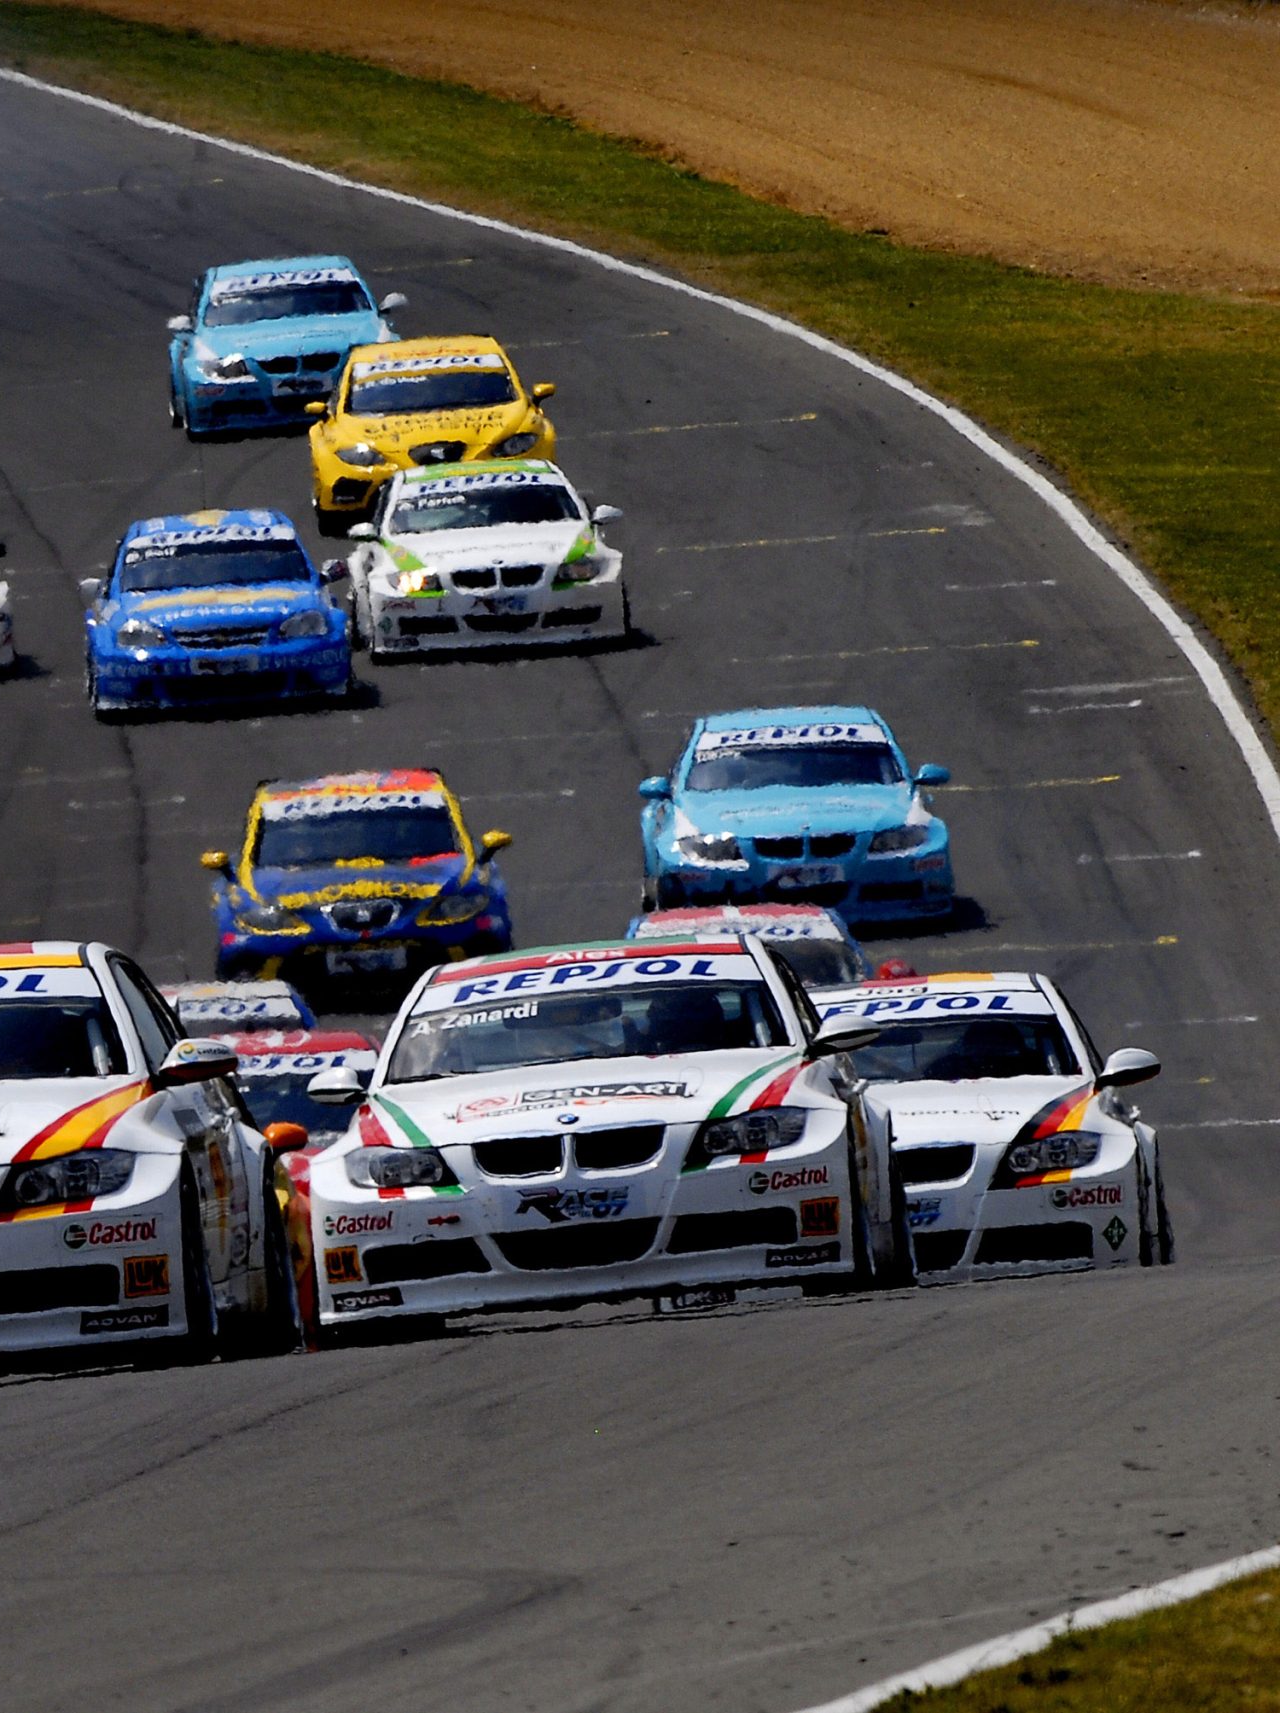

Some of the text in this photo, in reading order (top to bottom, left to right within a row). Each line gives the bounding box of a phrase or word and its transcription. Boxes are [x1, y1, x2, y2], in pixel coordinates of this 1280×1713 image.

[453, 959, 719, 1004] REPSOL
[441, 1000, 539, 1031] Zanardi
[524, 1082, 685, 1102] GEN-ART
[770, 1166, 829, 1190] Castrol
[1069, 1185, 1121, 1208] Castrol
[89, 1218, 157, 1245] Castrol
[336, 1210, 394, 1235] Castrol
[86, 1314, 158, 1327] ADVAN
